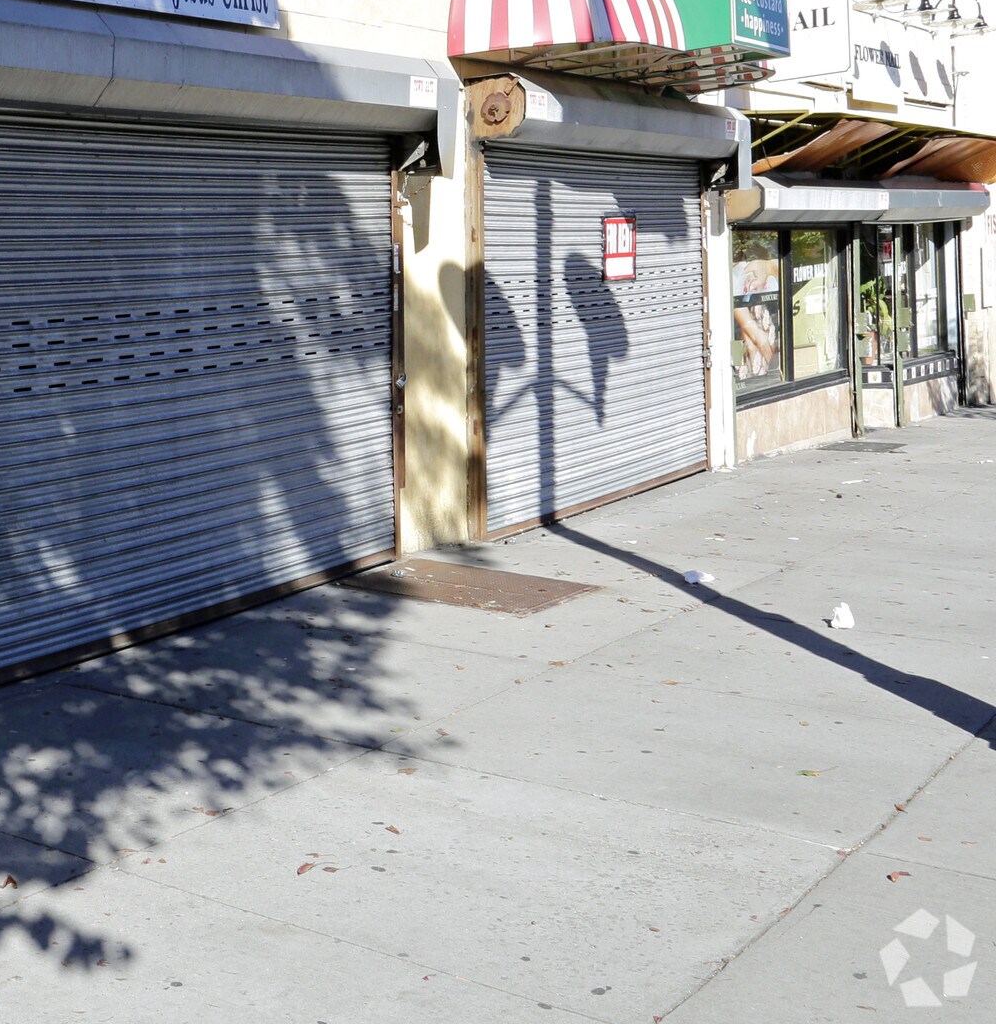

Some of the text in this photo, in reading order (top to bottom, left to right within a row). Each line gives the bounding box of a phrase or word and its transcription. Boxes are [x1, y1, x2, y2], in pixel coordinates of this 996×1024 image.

[744, 7, 781, 38] happiness
[791, 5, 836, 32] AIL
[854, 43, 885, 65] FLOWER
